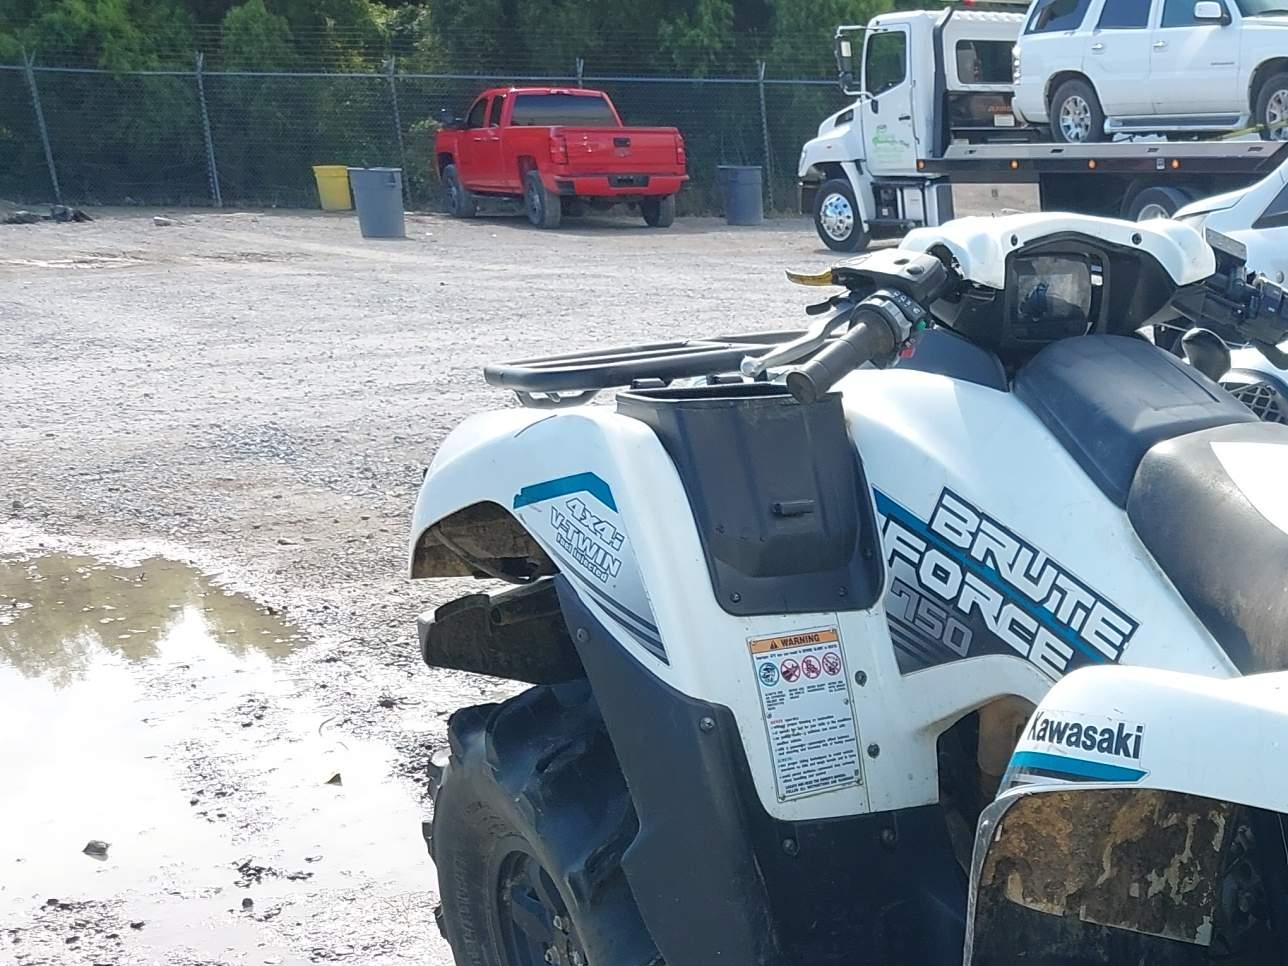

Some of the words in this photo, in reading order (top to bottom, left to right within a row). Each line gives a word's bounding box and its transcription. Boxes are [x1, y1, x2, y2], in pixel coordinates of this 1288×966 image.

[551, 505, 622, 578] V-TWIN
[929, 489, 1137, 661] BRUTE
[883, 518, 1075, 683] FORCE
[889, 577, 974, 658] 750
[780, 633, 821, 648] WARNING
[1027, 710, 1145, 760] Kawasaki
